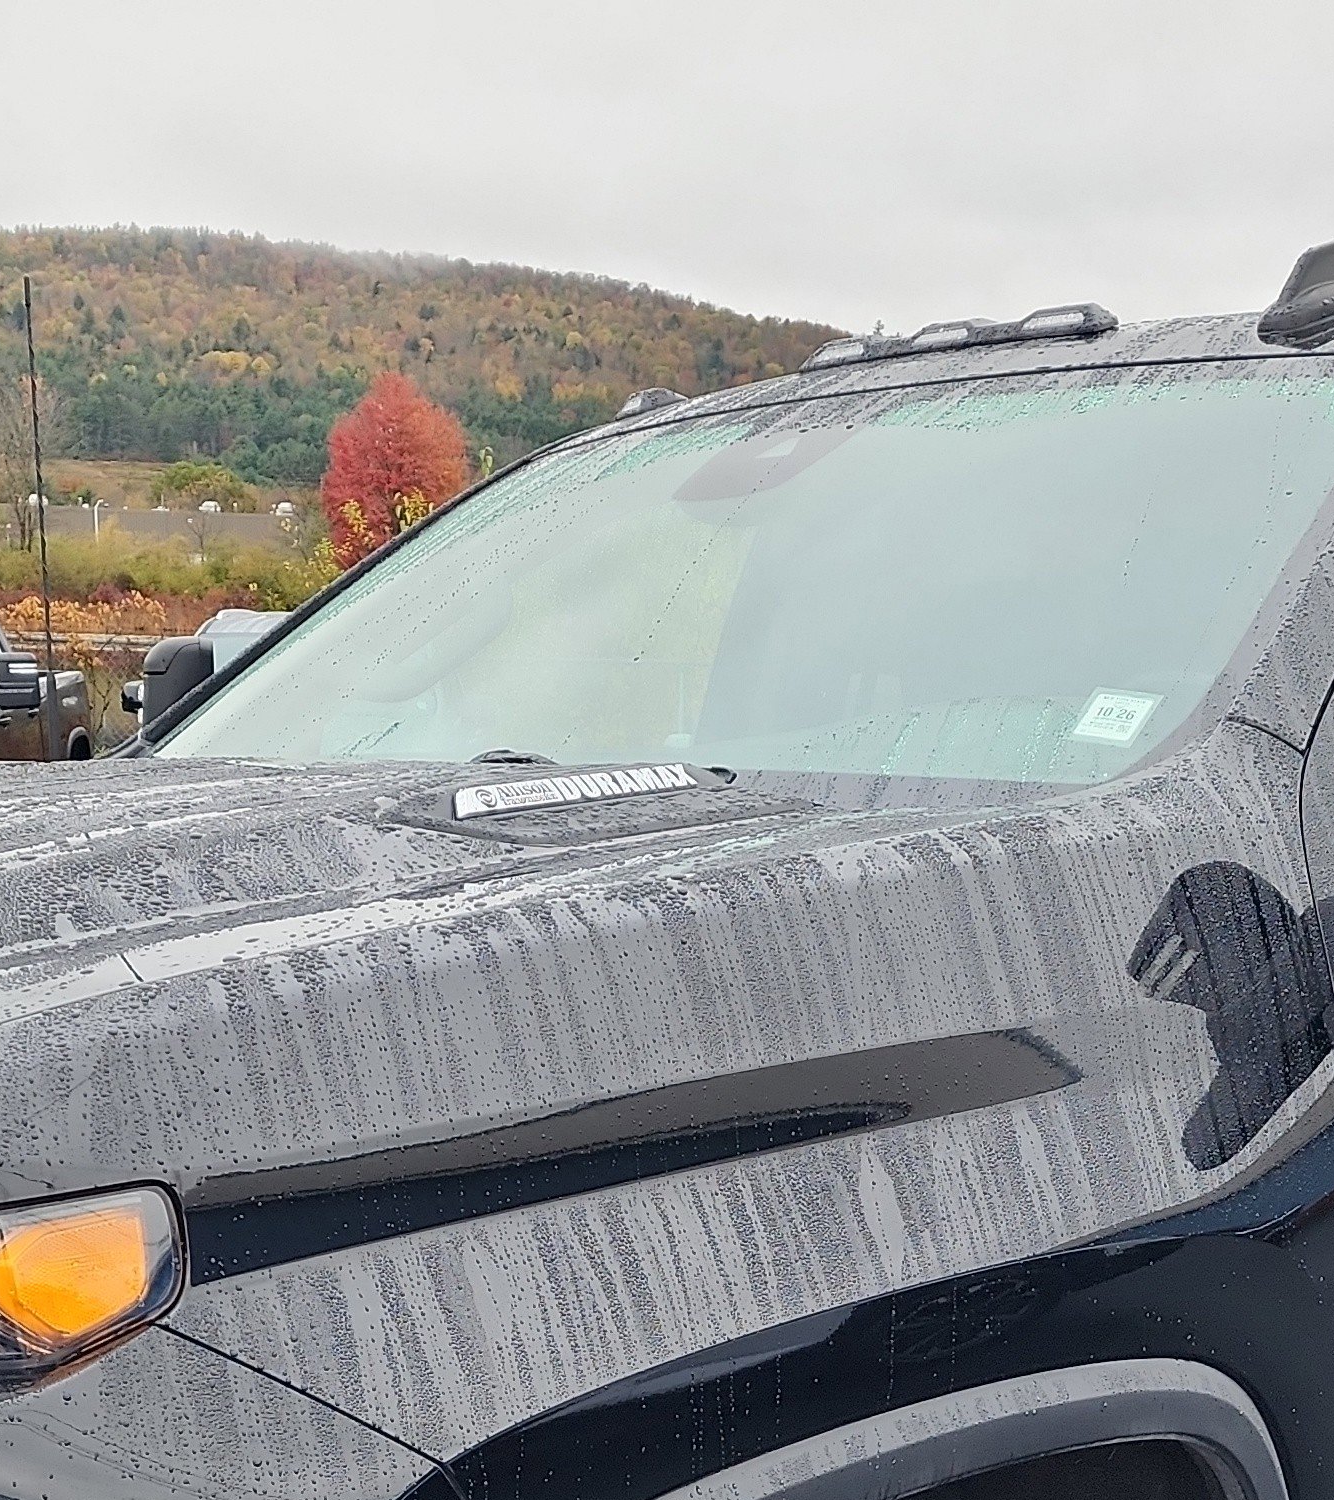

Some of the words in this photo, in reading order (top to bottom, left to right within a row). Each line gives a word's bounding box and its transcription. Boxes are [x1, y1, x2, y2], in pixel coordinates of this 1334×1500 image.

[1097, 707, 1114, 716] 10
[1116, 708, 1136, 720] 26
[496, 781, 552, 798] Allison
[549, 763, 698, 801] DURAMAX
